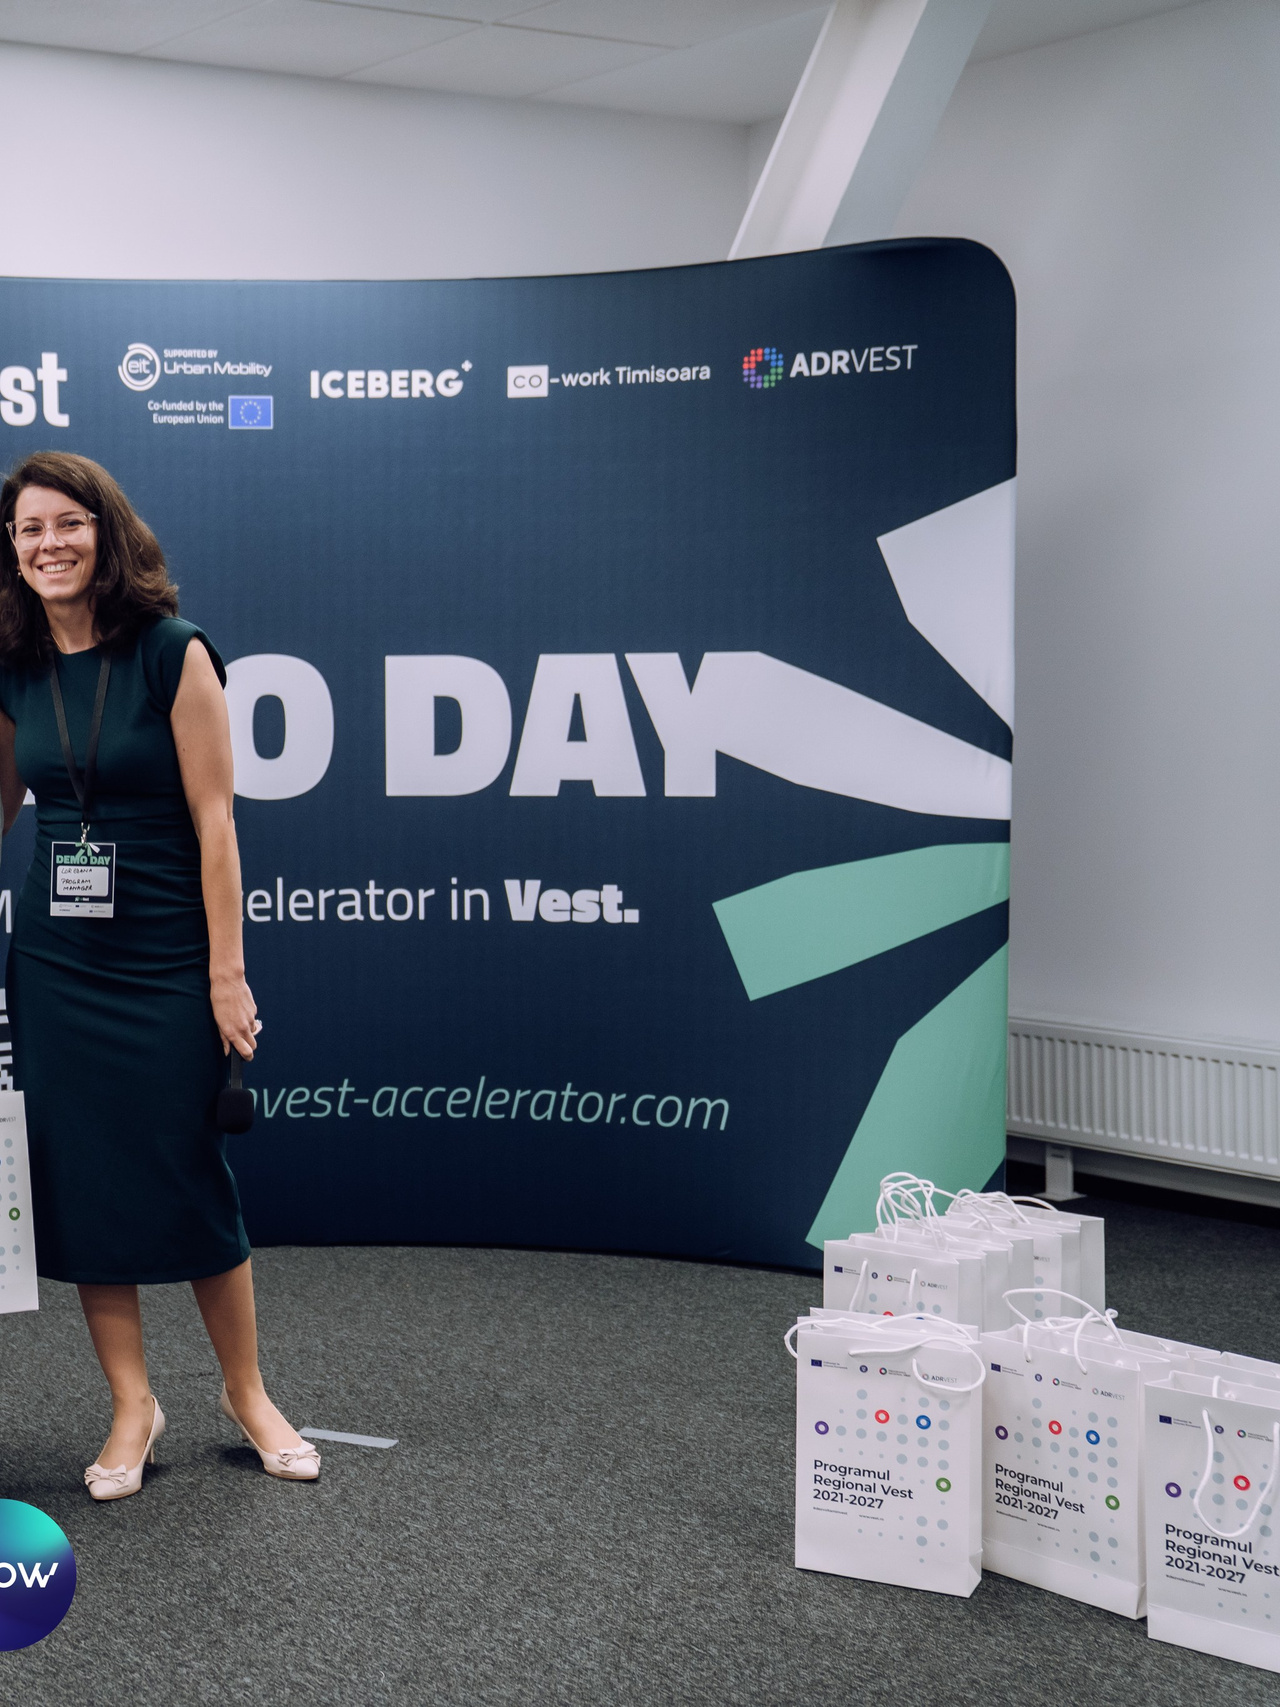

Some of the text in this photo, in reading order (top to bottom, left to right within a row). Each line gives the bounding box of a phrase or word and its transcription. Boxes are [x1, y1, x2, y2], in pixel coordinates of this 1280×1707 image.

[127, 358, 151, 374] eit
[163, 349, 218, 358] SUPPORTED BY
[790, 344, 918, 378] ADRVEST
[163, 361, 272, 377] Urban Mobility
[615, 365, 711, 384] Timisoara
[147, 400, 224, 412] Co-funded by the
[152, 414, 224, 425] European Union
[386, 652, 732, 797] DAY
[55, 854, 111, 865] DEMO DAY
[242, 877, 640, 924] elerator in Vest.
[813, 1459, 890, 1481] Programul
[995, 1463, 1063, 1493] Programul
[813, 1474, 914, 1500] Regional Vest
[813, 1488, 884, 1509] 2021-2027
[995, 1478, 1086, 1515] Regional Vest
[995, 1492, 1059, 1520] 2021-2027
[1165, 1523, 1253, 1554] Programul
[1165, 1539, 1280, 1577] Regional Vest
[1165, 1555, 1246, 1584] 2021-2027
